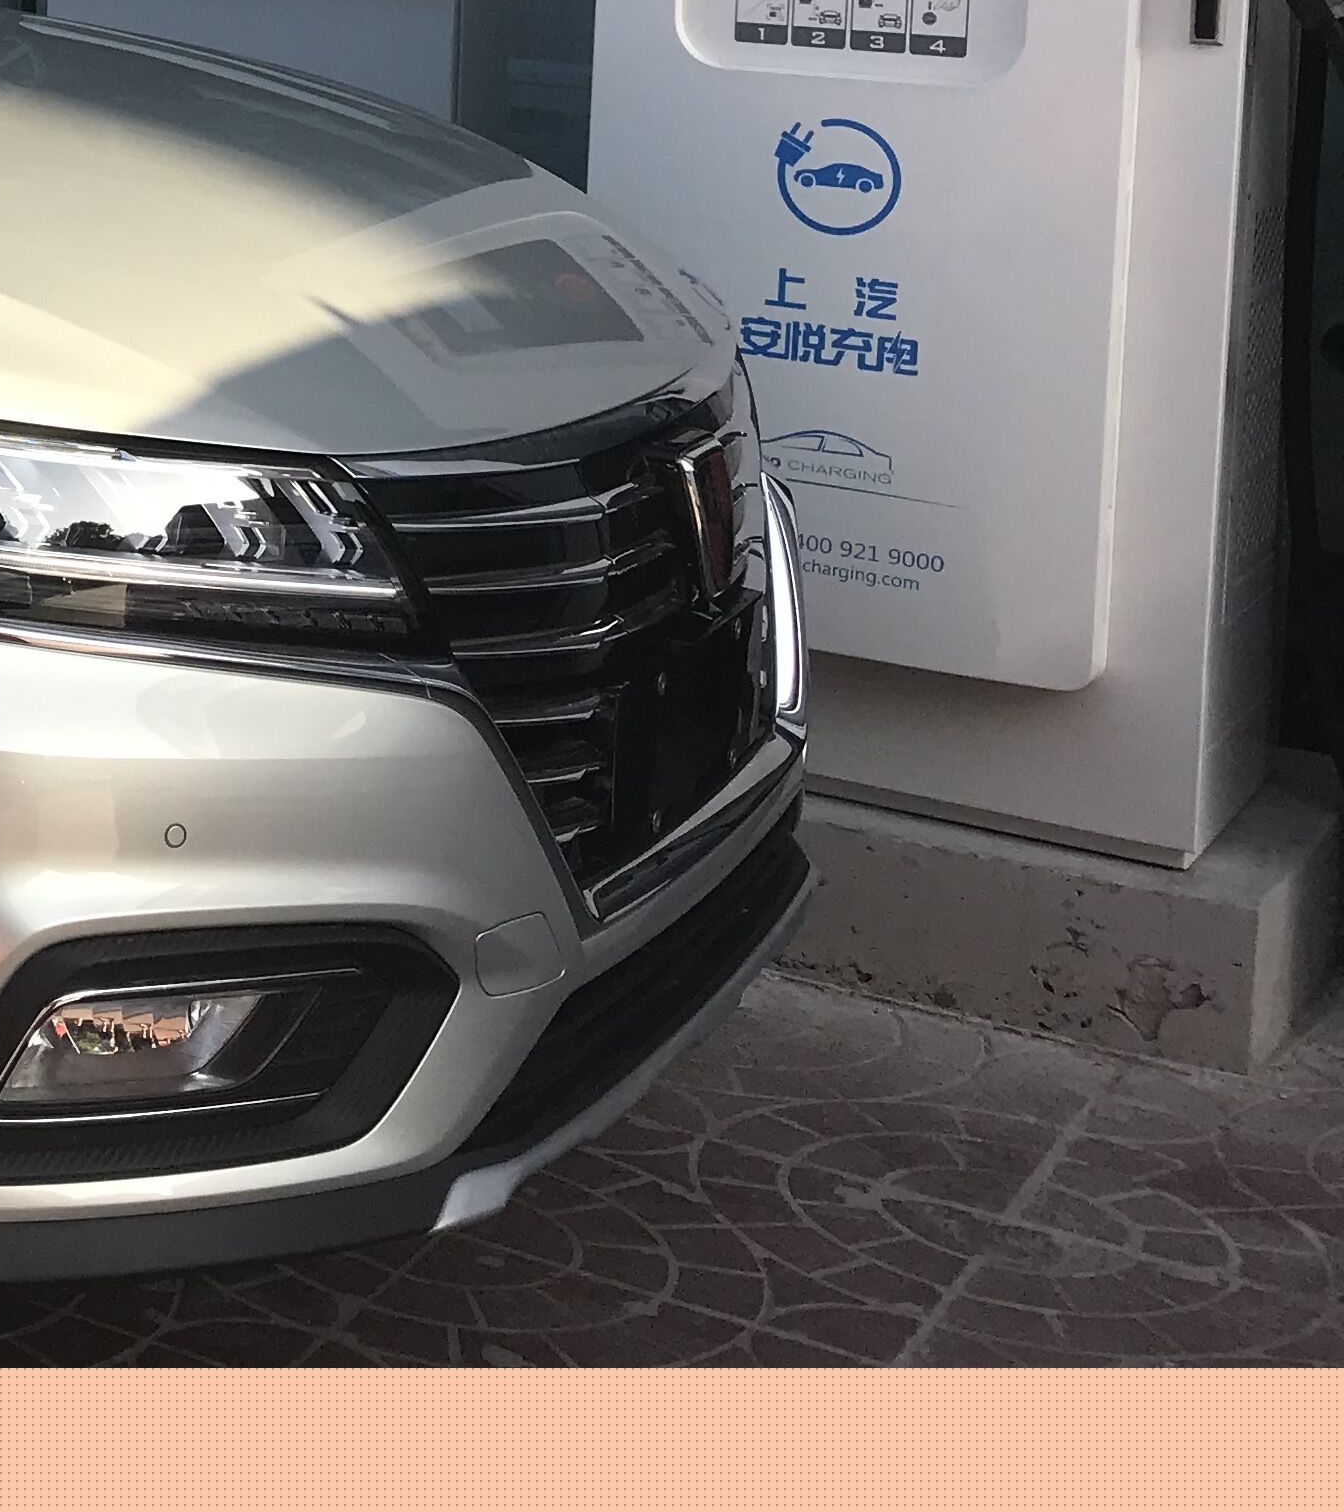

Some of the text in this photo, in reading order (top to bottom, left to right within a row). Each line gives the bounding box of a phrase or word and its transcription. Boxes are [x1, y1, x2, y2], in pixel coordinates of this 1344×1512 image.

[757, 27, 766, 41] 1
[811, 31, 826, 45] 2
[869, 35, 884, 49] 3
[929, 39, 946, 54] 4
[740, 316, 919, 376] 安悦充电
[787, 459, 894, 485] CHARGING
[839, 540, 880, 563] 921
[888, 548, 945, 573] 9000
